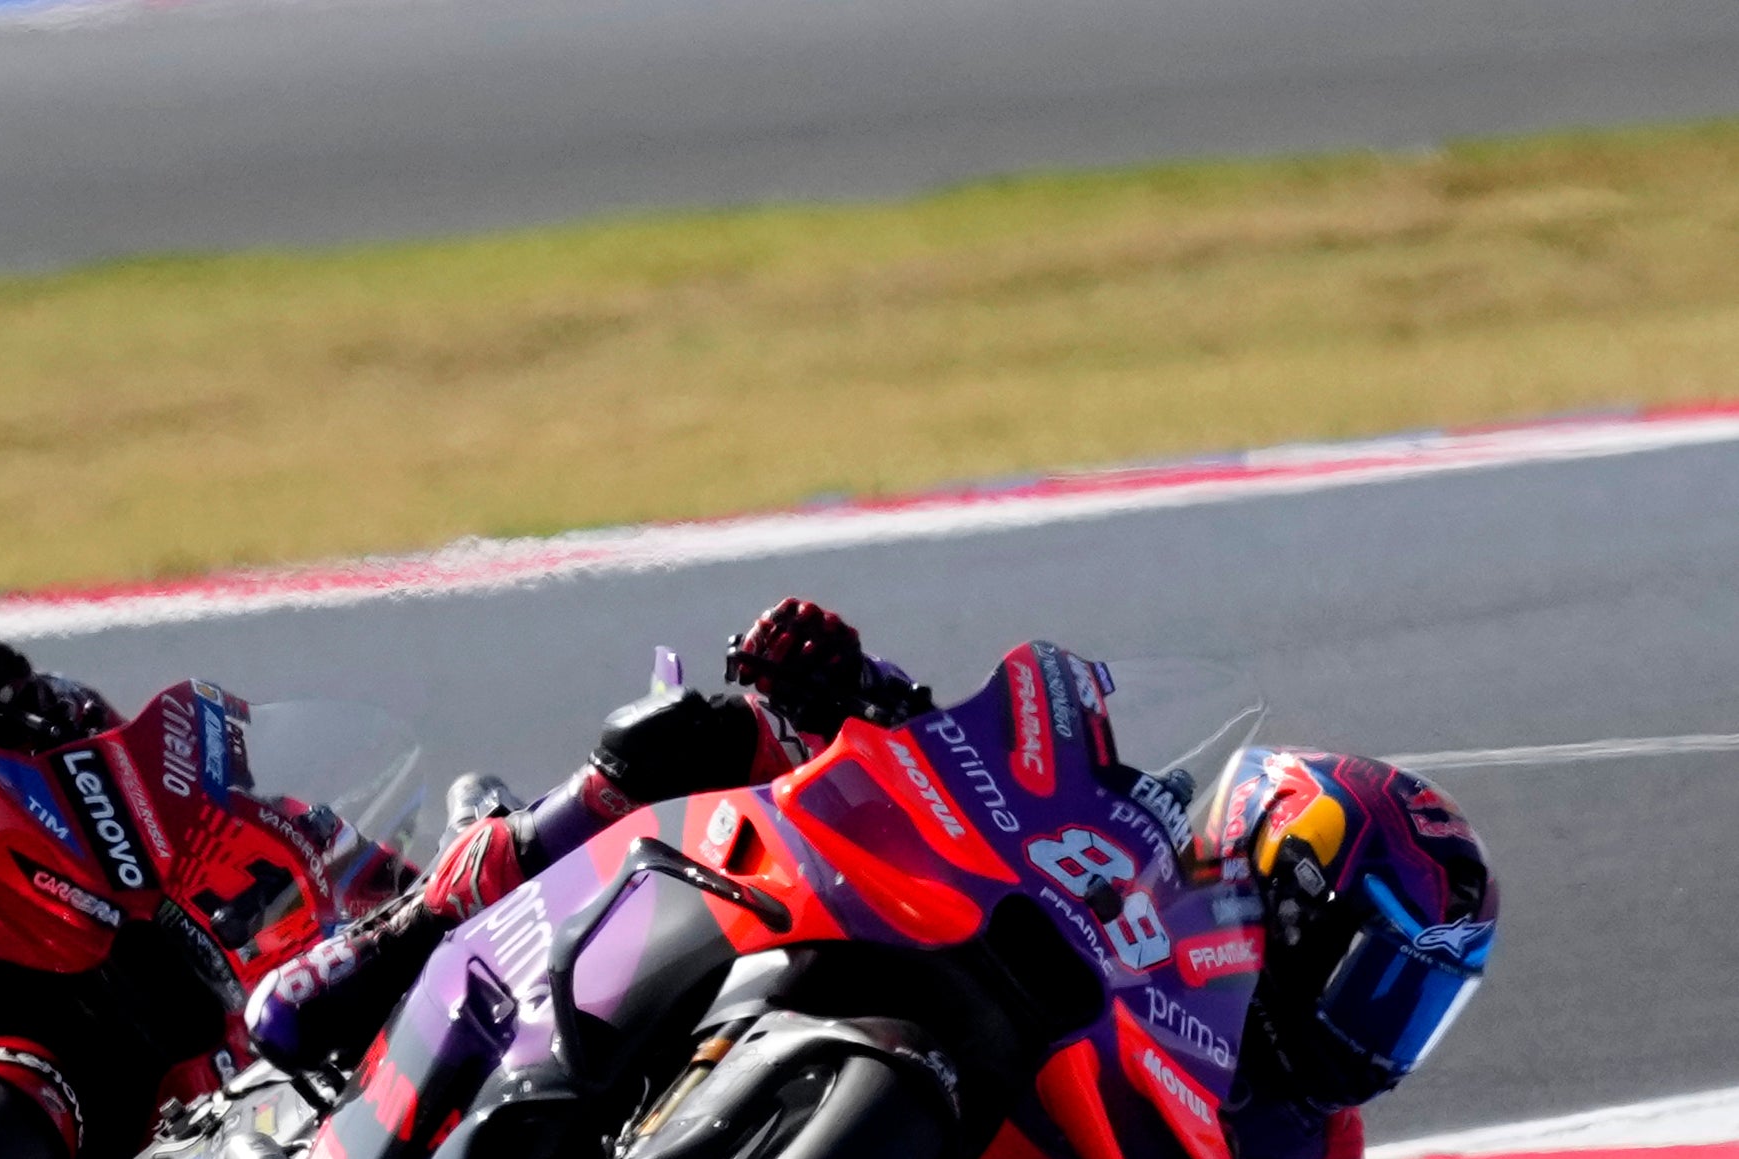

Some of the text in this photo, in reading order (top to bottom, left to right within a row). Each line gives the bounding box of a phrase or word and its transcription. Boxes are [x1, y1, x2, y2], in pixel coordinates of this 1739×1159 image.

[1013, 661, 1044, 775] PRAMAC
[28, 795, 70, 840] TIM
[63, 750, 144, 888] Lenovo
[885, 740, 966, 838] MOTUL
[925, 713, 1020, 832] prima
[1131, 774, 1193, 856] FIAMM
[1025, 826, 1172, 974] 89
[1146, 987, 1229, 1068] prima
[1143, 1049, 1211, 1125] MOTUL
